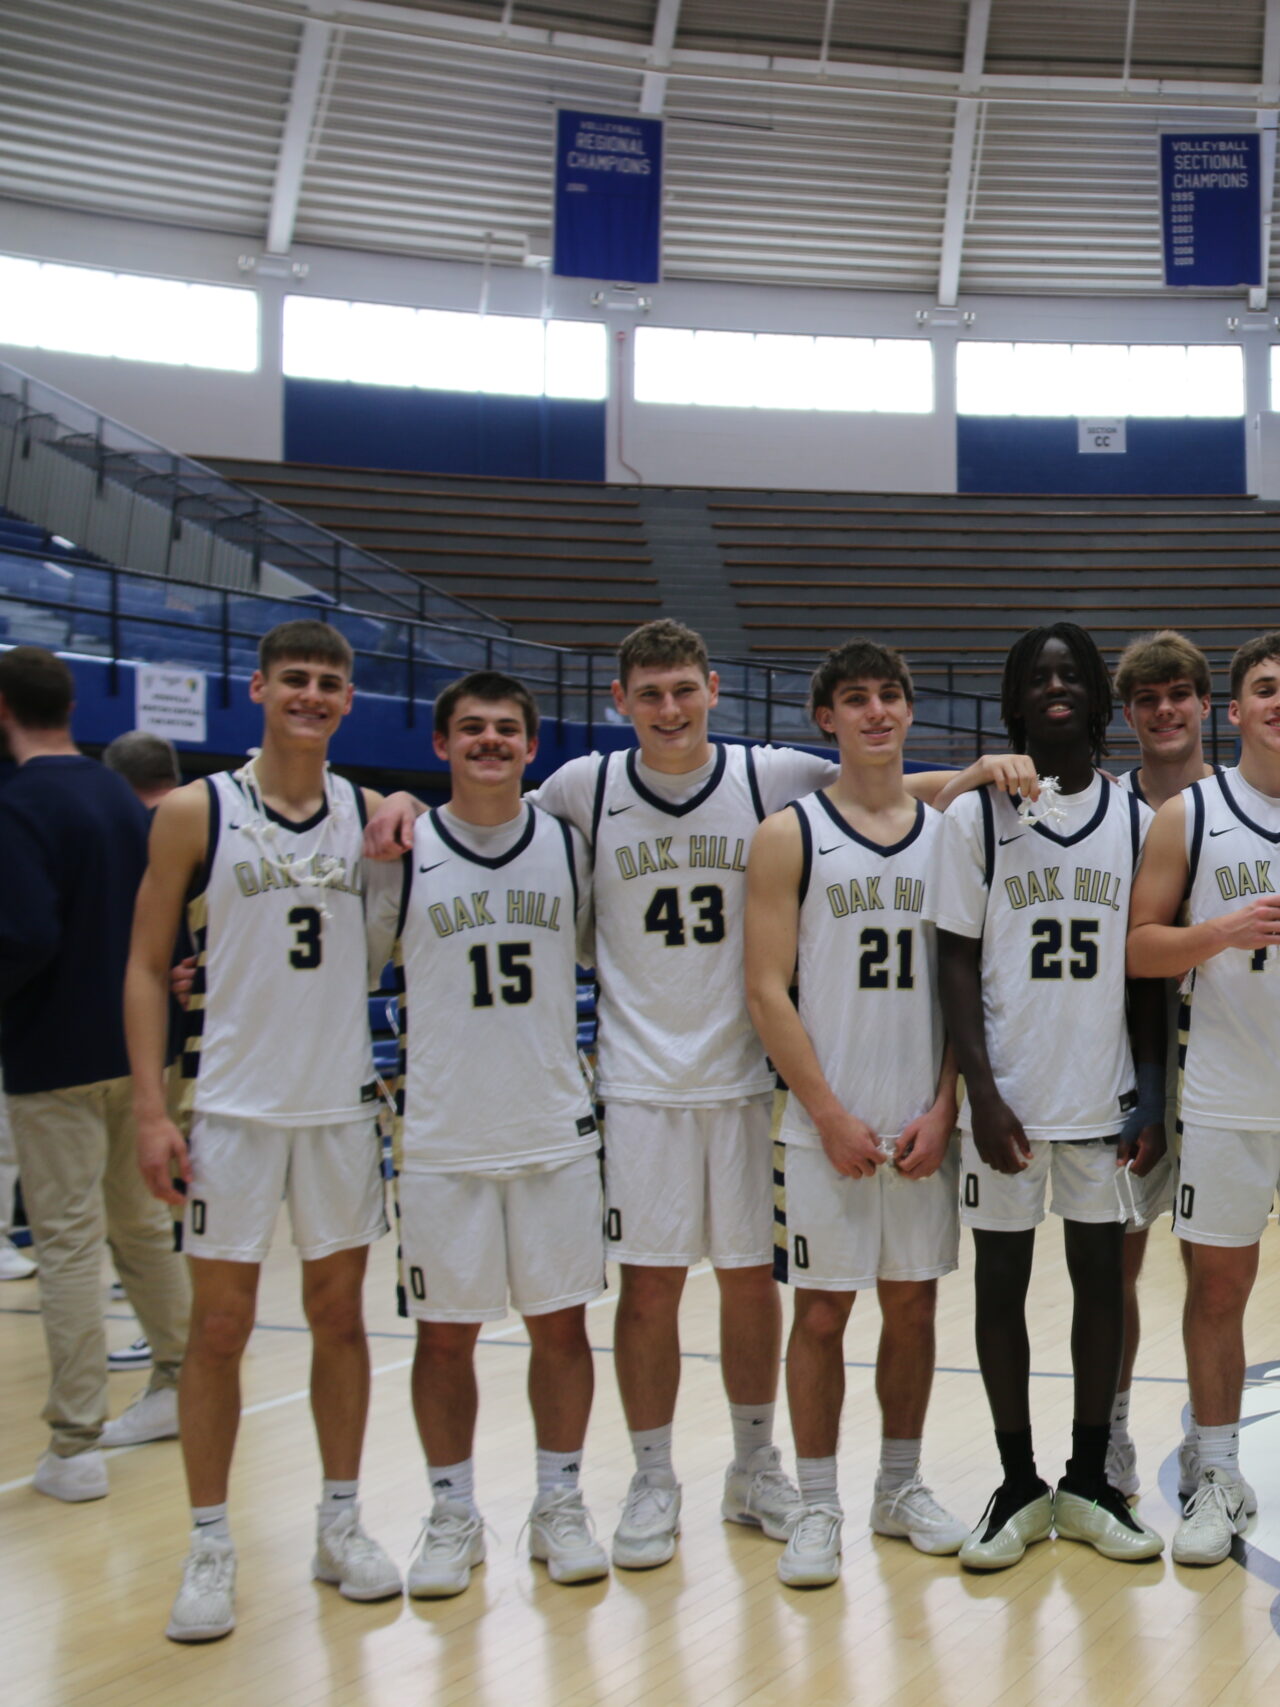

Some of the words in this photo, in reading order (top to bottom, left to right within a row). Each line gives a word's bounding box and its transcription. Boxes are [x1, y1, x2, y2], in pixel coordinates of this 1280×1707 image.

[567, 151, 651, 175] CHAMPIONS
[576, 132, 646, 155] REGIONAL
[1171, 141, 1249, 151] VOLLEYBALL
[1174, 154, 1248, 170] SECTIONAL
[1171, 192, 1195, 201] 1995
[1173, 173, 1249, 188] CHAMPIONS
[1095, 435, 1111, 448] CC
[615, 836, 679, 880] OAK
[689, 834, 747, 872] HILL
[826, 876, 884, 918] OAK
[894, 876, 925, 914] HI
[1004, 866, 1064, 910] OAK
[1074, 866, 1121, 911] HILL
[1215, 860, 1276, 901] OAK
[427, 890, 496, 939] OAK
[506, 889, 561, 932] HILL
[644, 884, 726, 947] 43
[288, 905, 323, 970] 3
[859, 927, 915, 989] 21
[1030, 917, 1100, 980] 25
[468, 941, 534, 1008] 15
